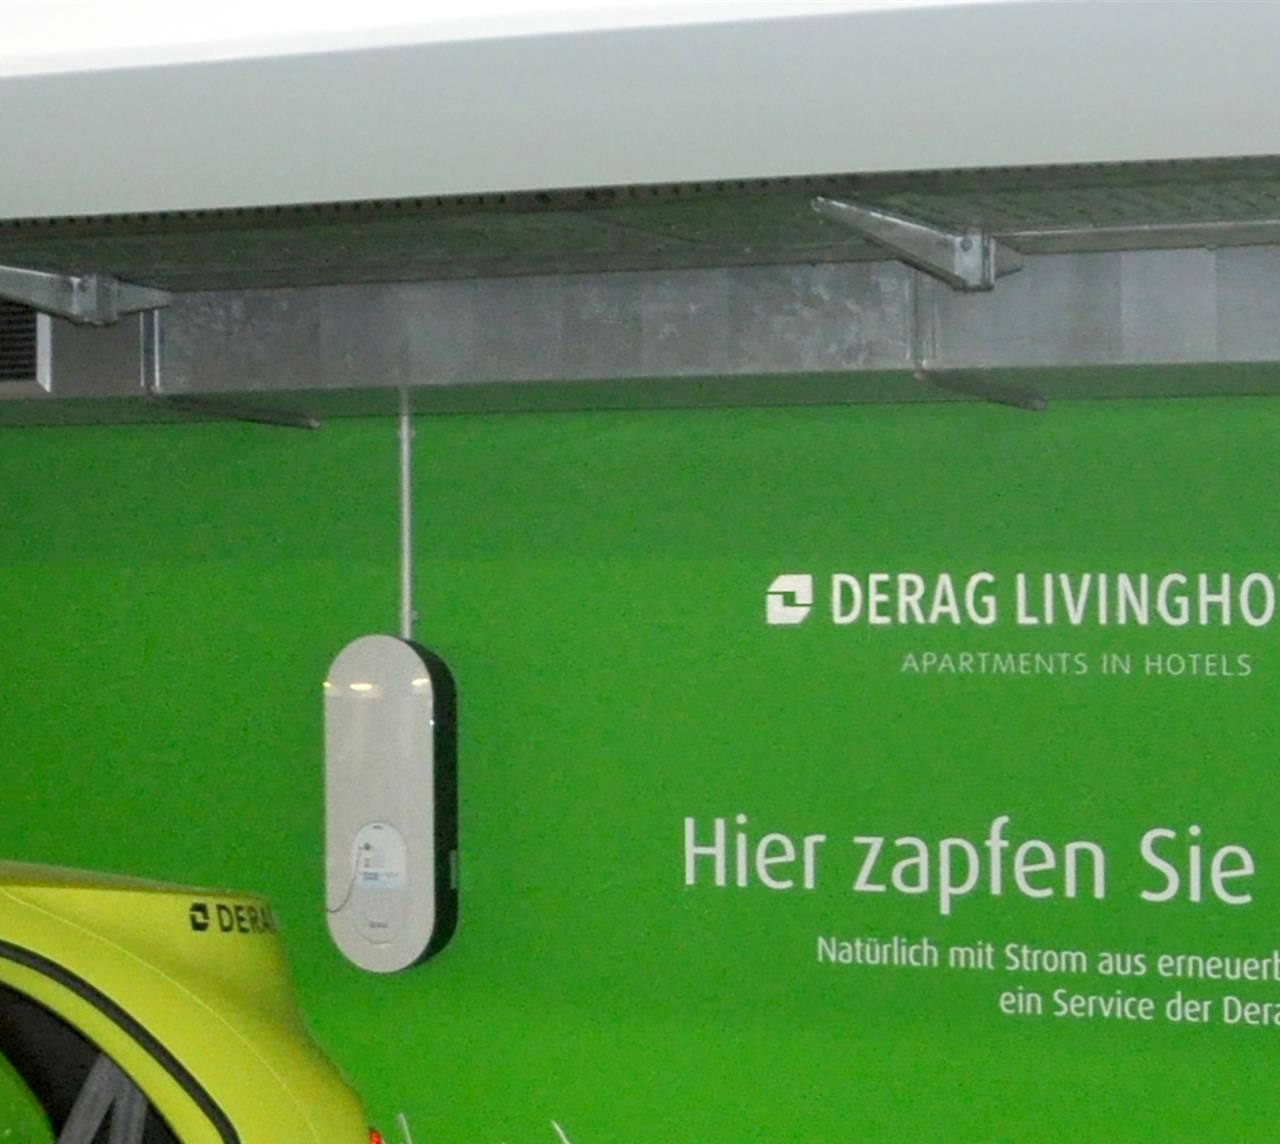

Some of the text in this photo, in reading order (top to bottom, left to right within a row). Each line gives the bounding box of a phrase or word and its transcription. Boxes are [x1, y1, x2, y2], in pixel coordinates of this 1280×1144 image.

[831, 571, 997, 626] DERAG
[901, 651, 1252, 677] APARTMENTS IN HOTELS
[684, 813, 826, 890] Hier
[853, 815, 1106, 916] zapfen
[1140, 824, 1255, 905] Sie
[817, 935, 939, 967] Natürlich
[949, 940, 995, 970] mit
[1004, 943, 1088, 973] Strom
[1097, 952, 1148, 976] aus
[999, 985, 1043, 1015] ein
[1053, 988, 1155, 1021] Service
[1165, 990, 1213, 1023] der
